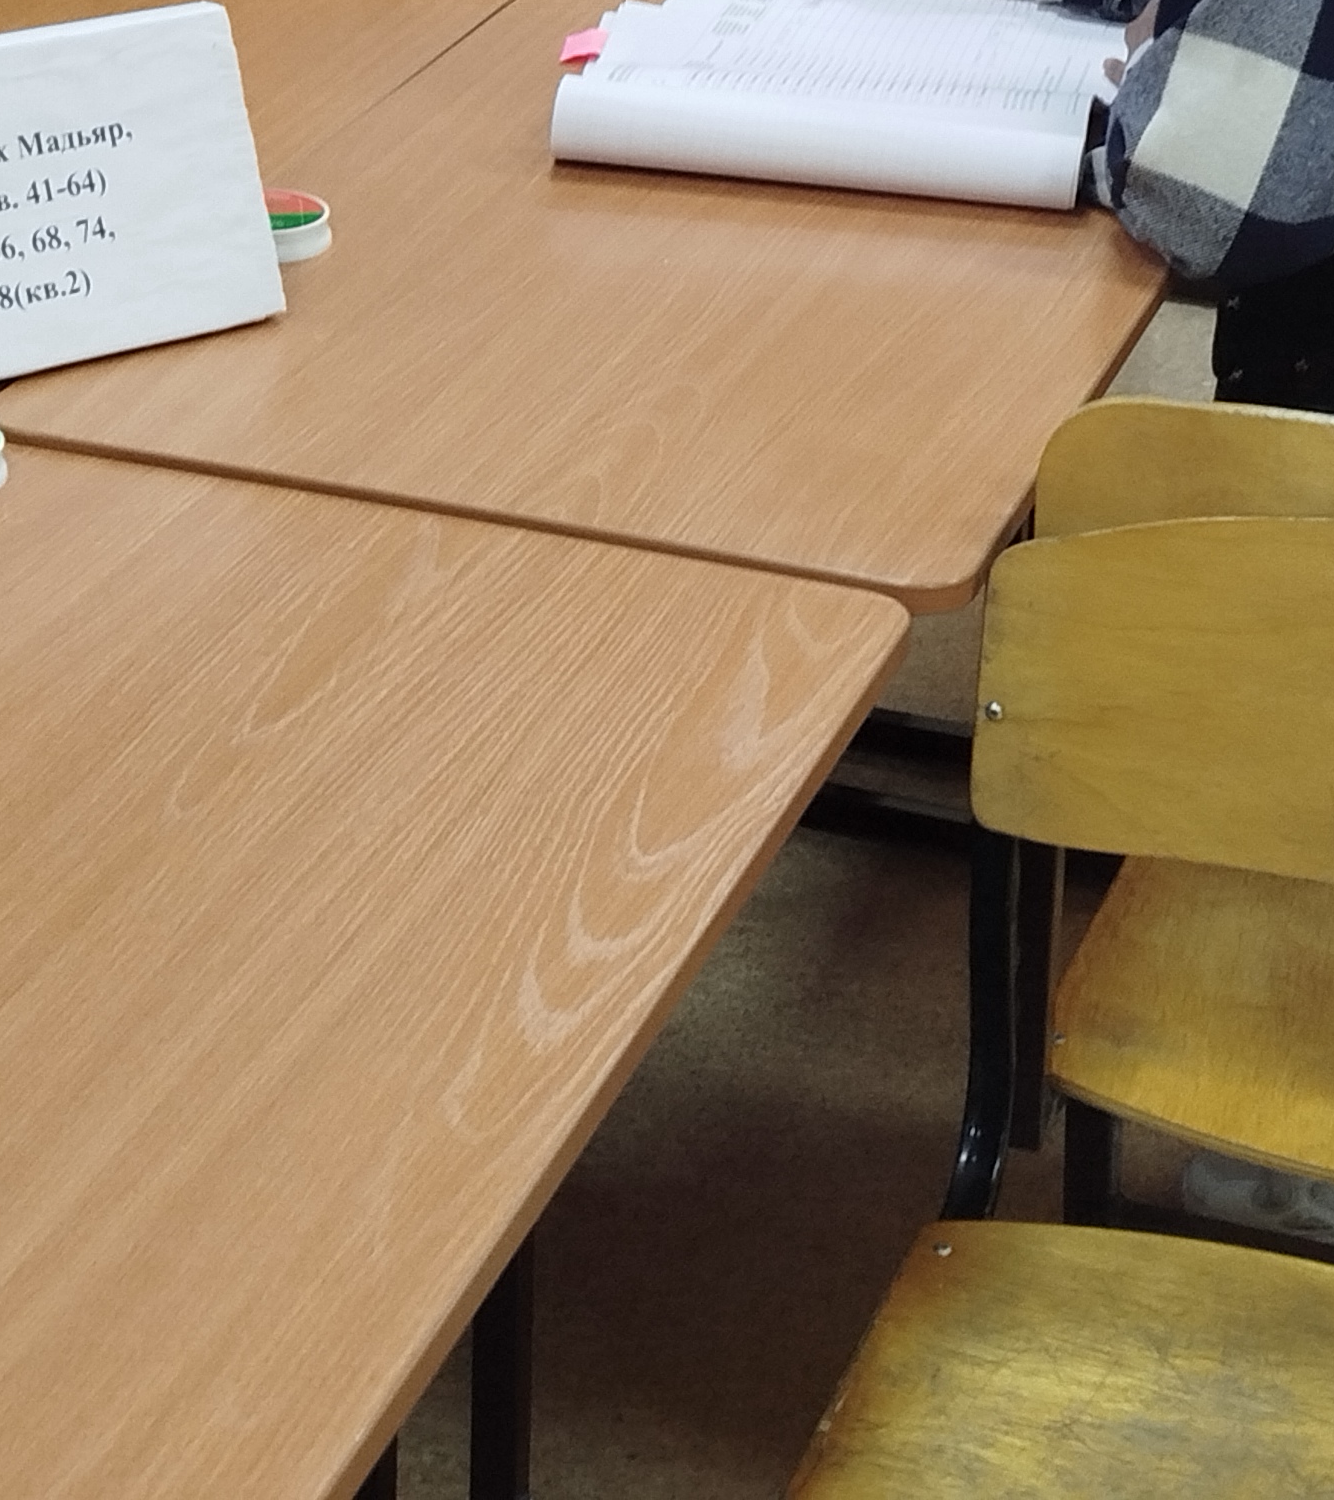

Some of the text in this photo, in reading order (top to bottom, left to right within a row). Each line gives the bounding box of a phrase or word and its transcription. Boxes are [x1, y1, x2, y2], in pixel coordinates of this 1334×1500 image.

[17, 121, 133, 159] Мадьяр,
[26, 168, 107, 205] 41-64)
[31, 225, 71, 253] 68,
[76, 215, 116, 243] 74,
